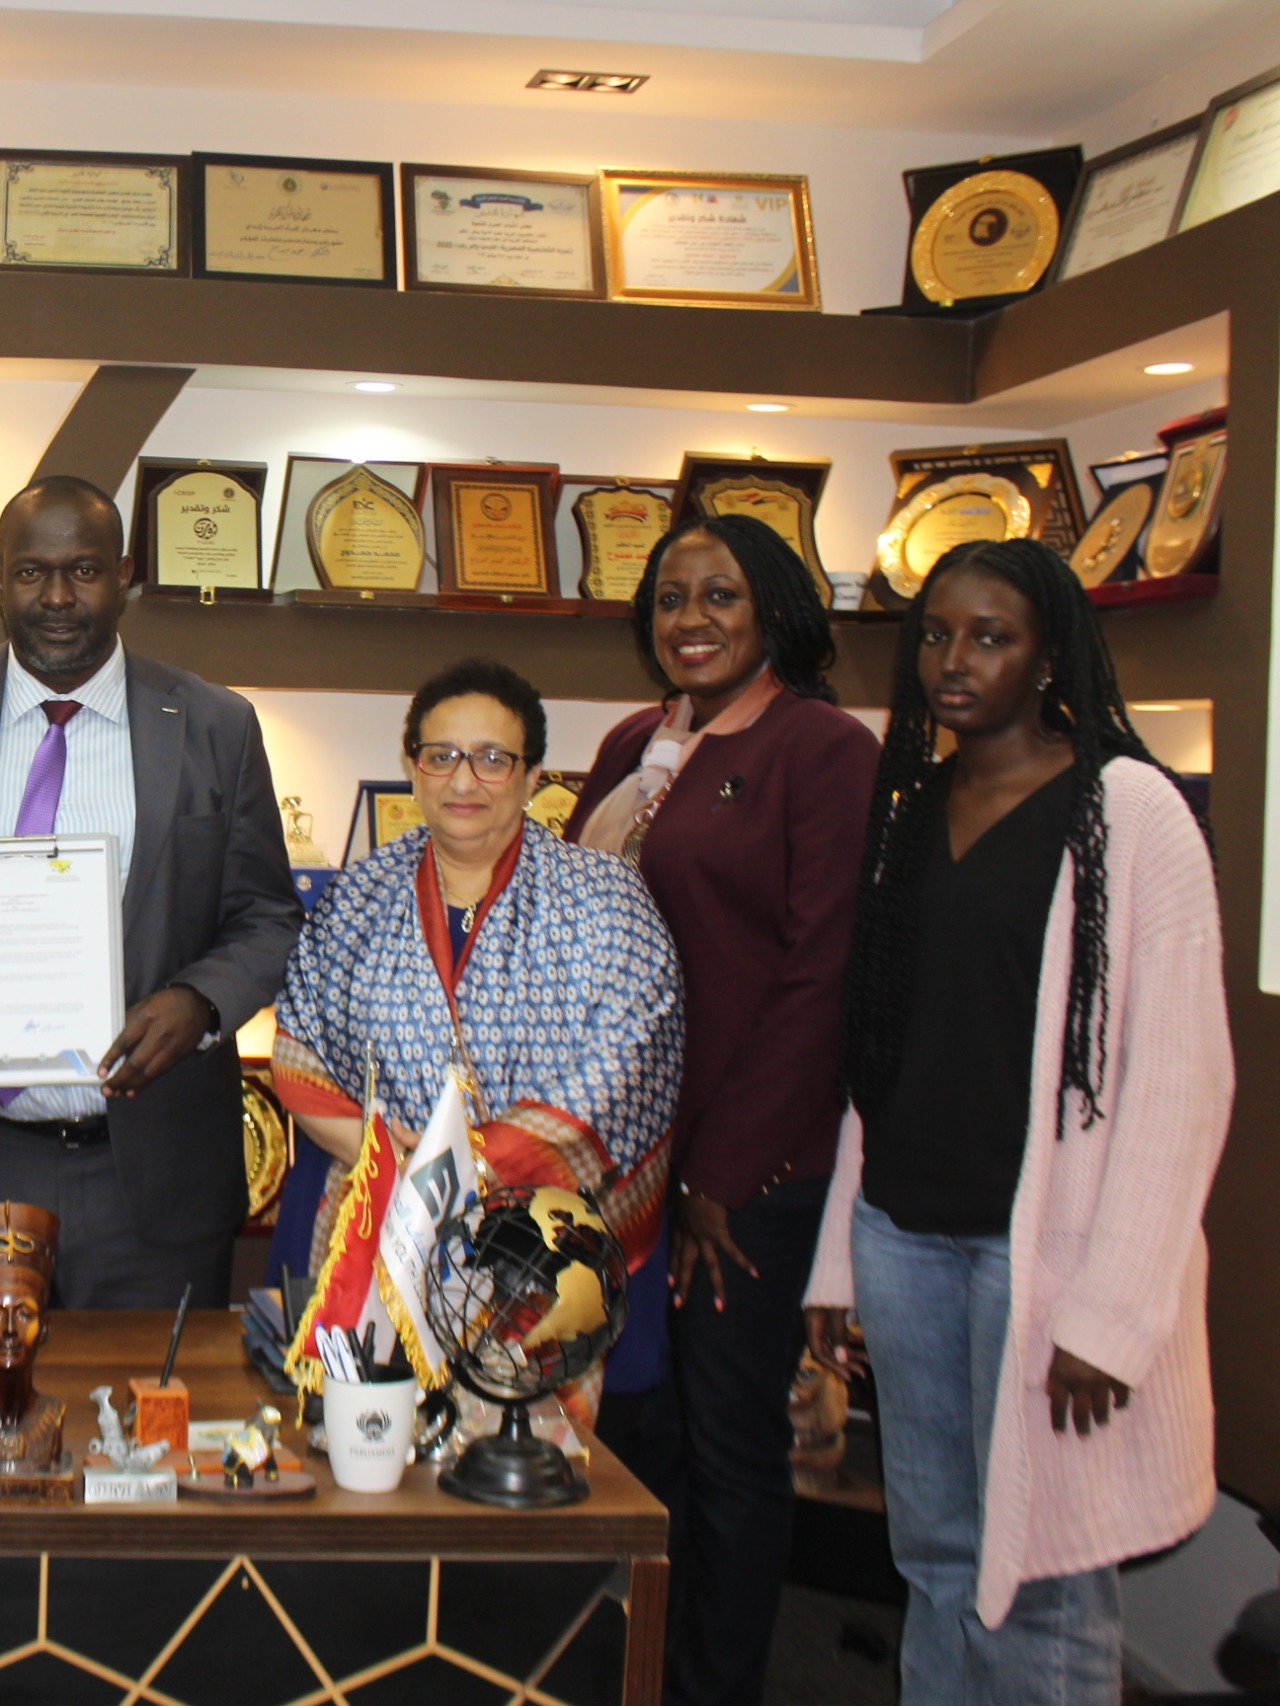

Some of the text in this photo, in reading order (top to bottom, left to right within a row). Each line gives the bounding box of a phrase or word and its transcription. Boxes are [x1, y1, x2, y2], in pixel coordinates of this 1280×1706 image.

[755, 196, 788, 211] VIP
[181, 504, 230, 514] شكر وتقدير
